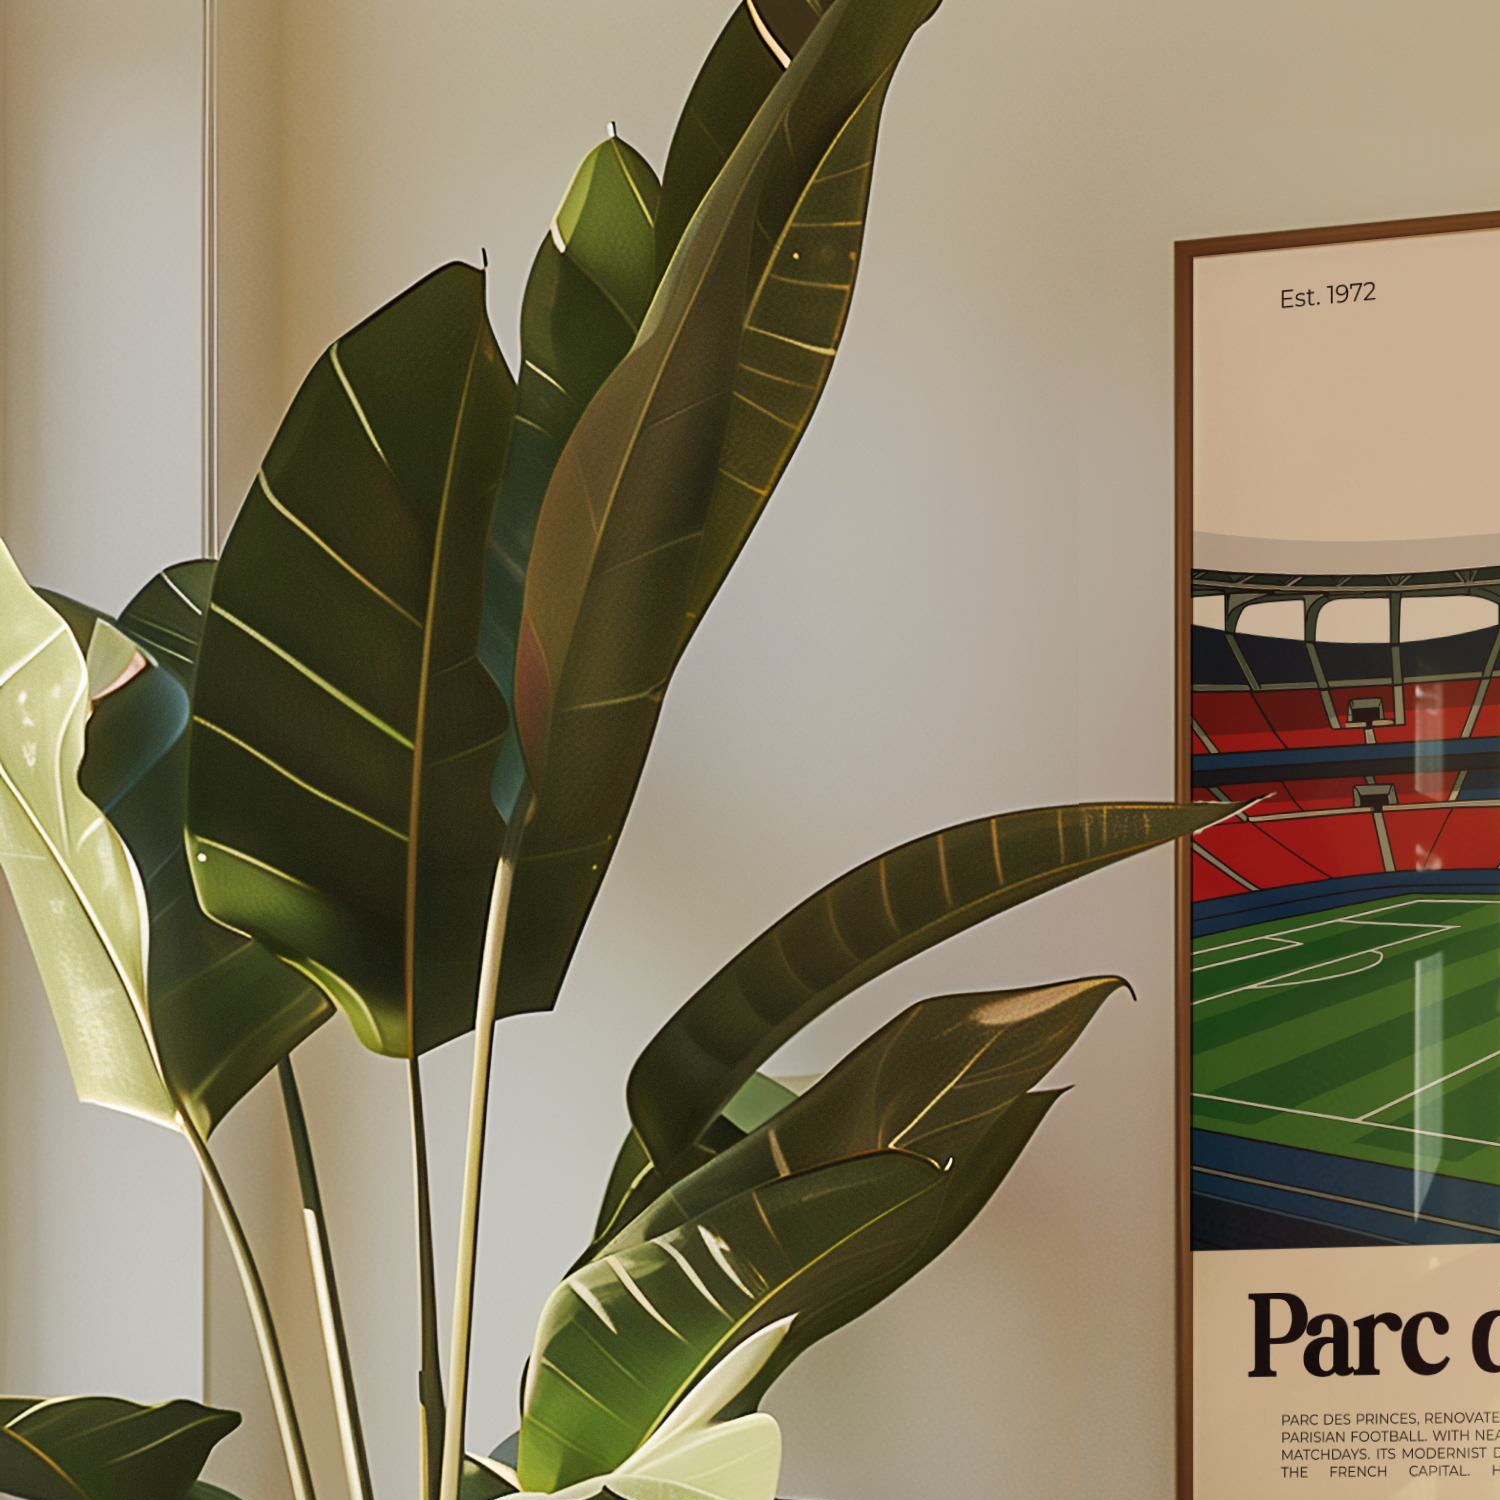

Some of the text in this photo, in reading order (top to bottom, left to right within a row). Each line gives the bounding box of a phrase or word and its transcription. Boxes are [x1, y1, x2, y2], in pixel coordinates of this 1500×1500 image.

[1281, 281, 1377, 309] Est. 1972
[1247, 1292, 1451, 1378] Parc
[1281, 1413, 1319, 1427] PARC
[1323, 1412, 1352, 1426] DES
[1356, 1412, 1420, 1426] PRINCES,
[1281, 1430, 1346, 1444] PARISIAN
[1350, 1429, 1428, 1443] FOOTBALL.
[1432, 1429, 1470, 1442] WITH
[1281, 1447, 1371, 1461] MATCHDAYS.
[1376, 1447, 1397, 1460] ITS
[1401, 1446, 1488, 1460] MODERNIST
[1280, 1465, 1309, 1479] THE
[1329, 1465, 1387, 1478] FRENCH
[1408, 1464, 1471, 1478] CAPITAL.
